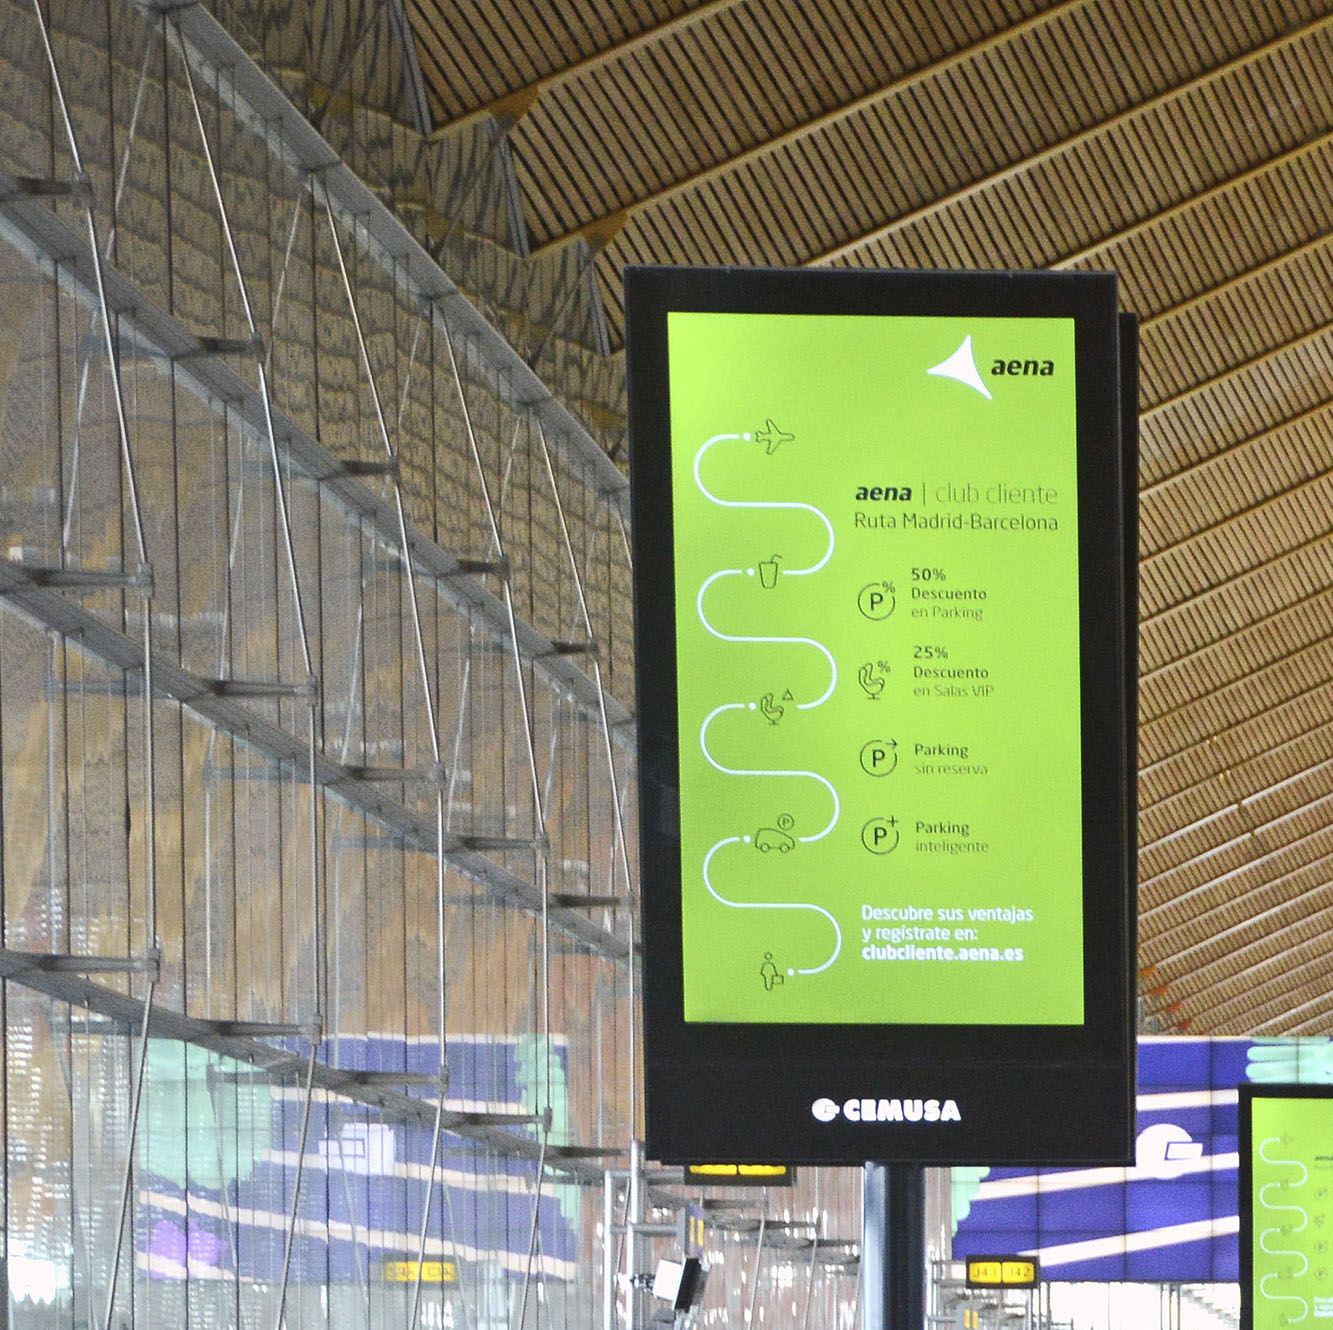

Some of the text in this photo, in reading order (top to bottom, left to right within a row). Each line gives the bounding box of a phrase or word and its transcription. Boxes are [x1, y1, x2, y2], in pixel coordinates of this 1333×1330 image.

[991, 359, 1055, 377] aena
[855, 483, 1058, 505] aena club cliente
[855, 512, 1059, 531] Ruta Madrid-Barcelona
[911, 567, 947, 582] 50%
[911, 587, 987, 601] Descuento
[911, 606, 983, 622] en Parking
[913, 645, 948, 660] 25%
[913, 665, 989, 679] Descuento
[913, 684, 995, 698] en Salas VIP
[914, 743, 969, 760] Parking
[915, 763, 988, 776] sin reserva
[915, 821, 970, 838] Parking
[916, 840, 990, 856] inteligente
[861, 904, 1034, 925] Descubre sus ventajas
[862, 928, 872, 943] y
[954, 928, 978, 941] en:
[862, 944, 1024, 962] clubcliente.aena.es
[842, 1098, 962, 1122] CEMUSA
